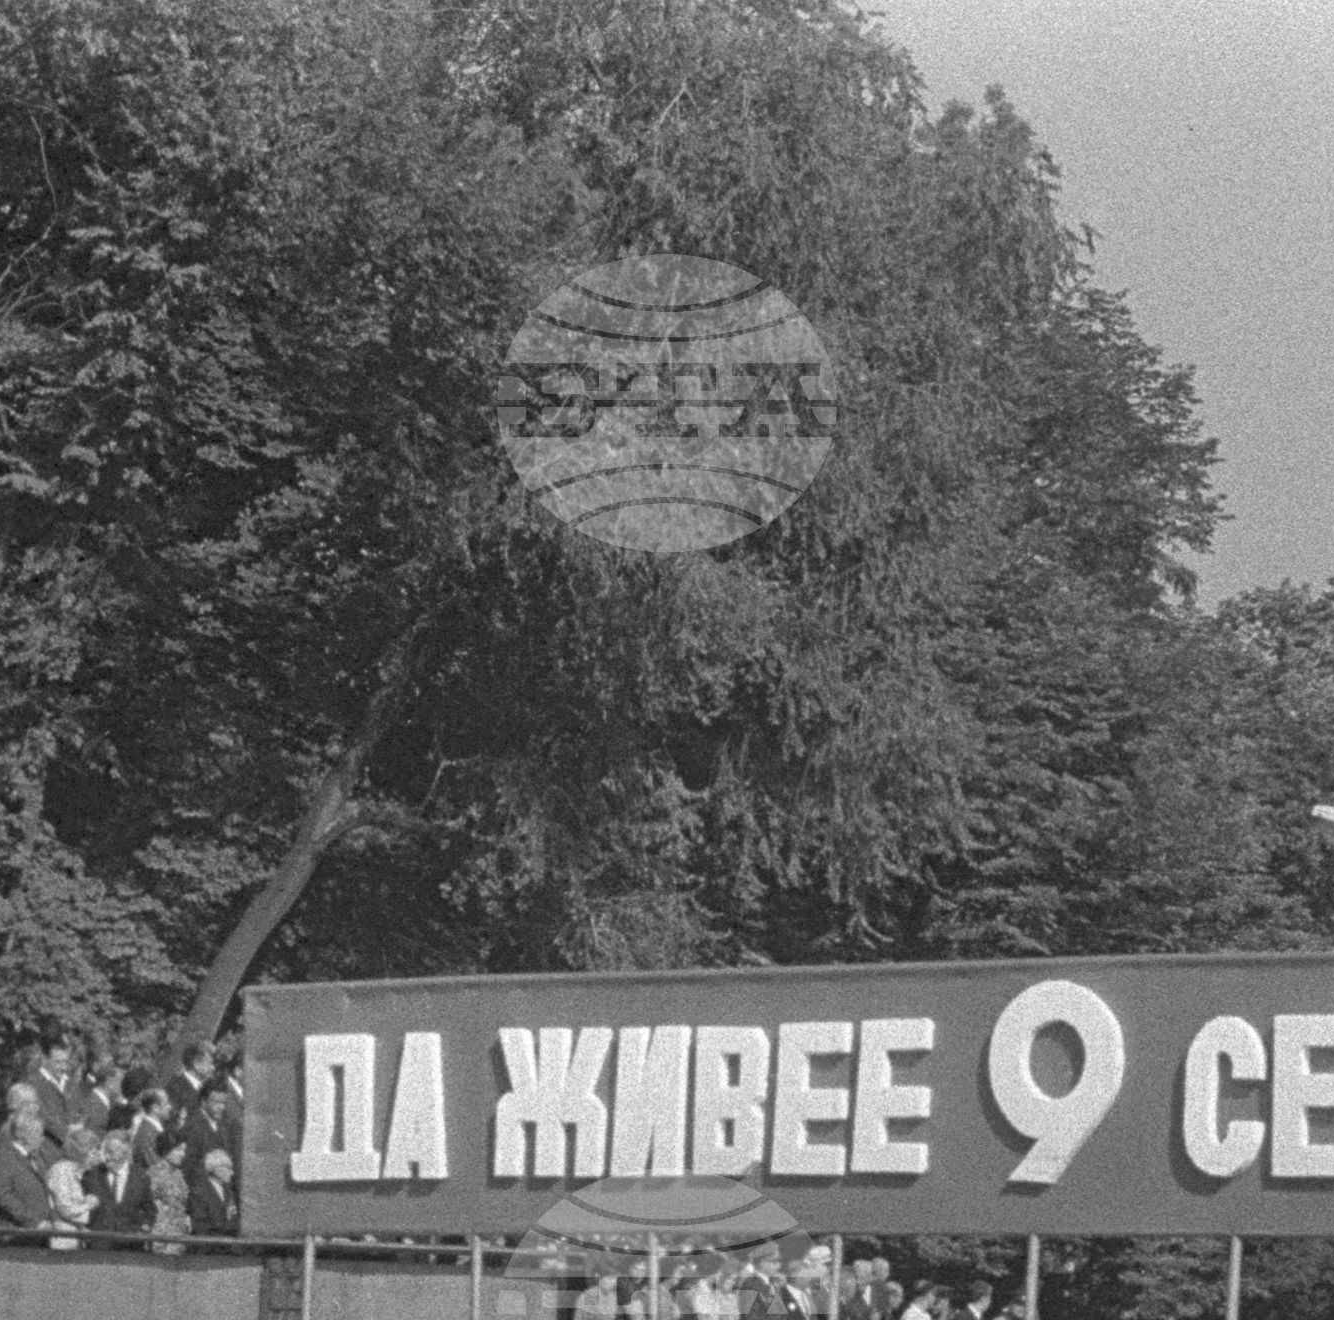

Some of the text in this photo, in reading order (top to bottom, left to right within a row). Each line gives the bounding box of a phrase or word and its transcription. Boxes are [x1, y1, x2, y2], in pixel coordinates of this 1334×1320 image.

[290, 1032, 449, 1183] ДА
[493, 1017, 936, 1179] ЖИВЕЕ
[988, 979, 1125, 1185] 9
